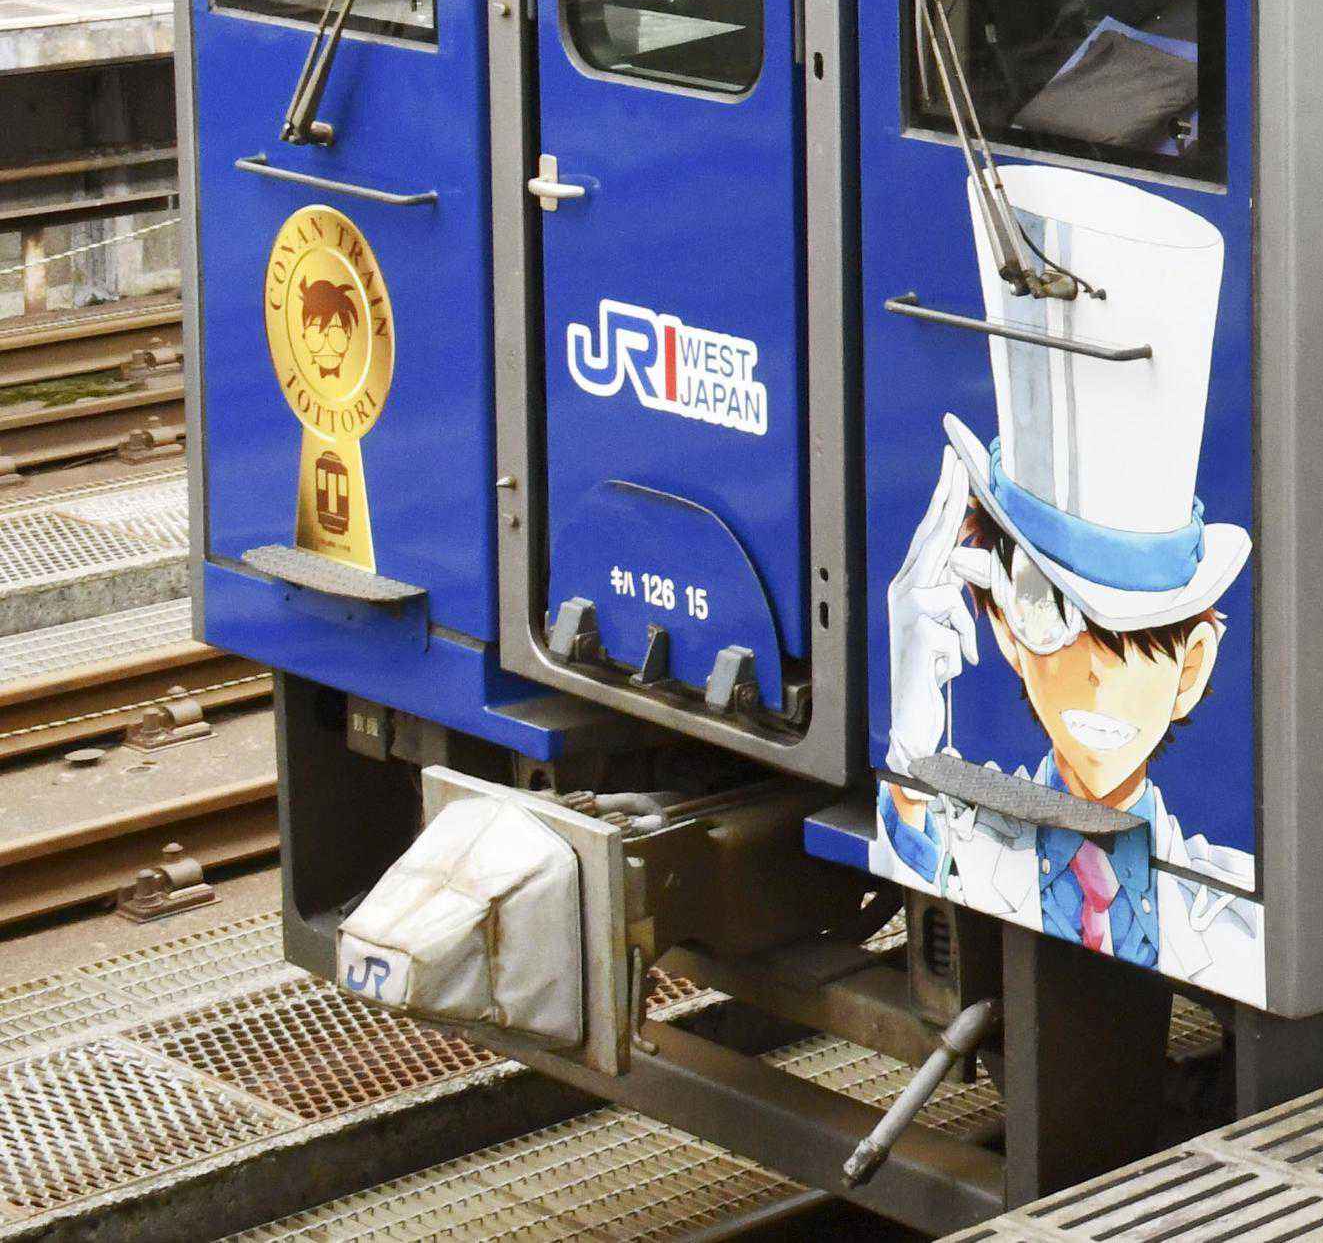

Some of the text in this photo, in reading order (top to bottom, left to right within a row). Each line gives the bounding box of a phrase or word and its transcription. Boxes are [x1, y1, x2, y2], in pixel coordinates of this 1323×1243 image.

[270, 216, 389, 338] CONAN TRAIN
[568, 299, 659, 408] JR
[680, 334, 751, 381] WEST
[285, 368, 378, 434] TOTTORI
[680, 379, 761, 424] JAPAN
[610, 566, 709, 620] キハ 126 15
[347, 956, 391, 1000] JR
